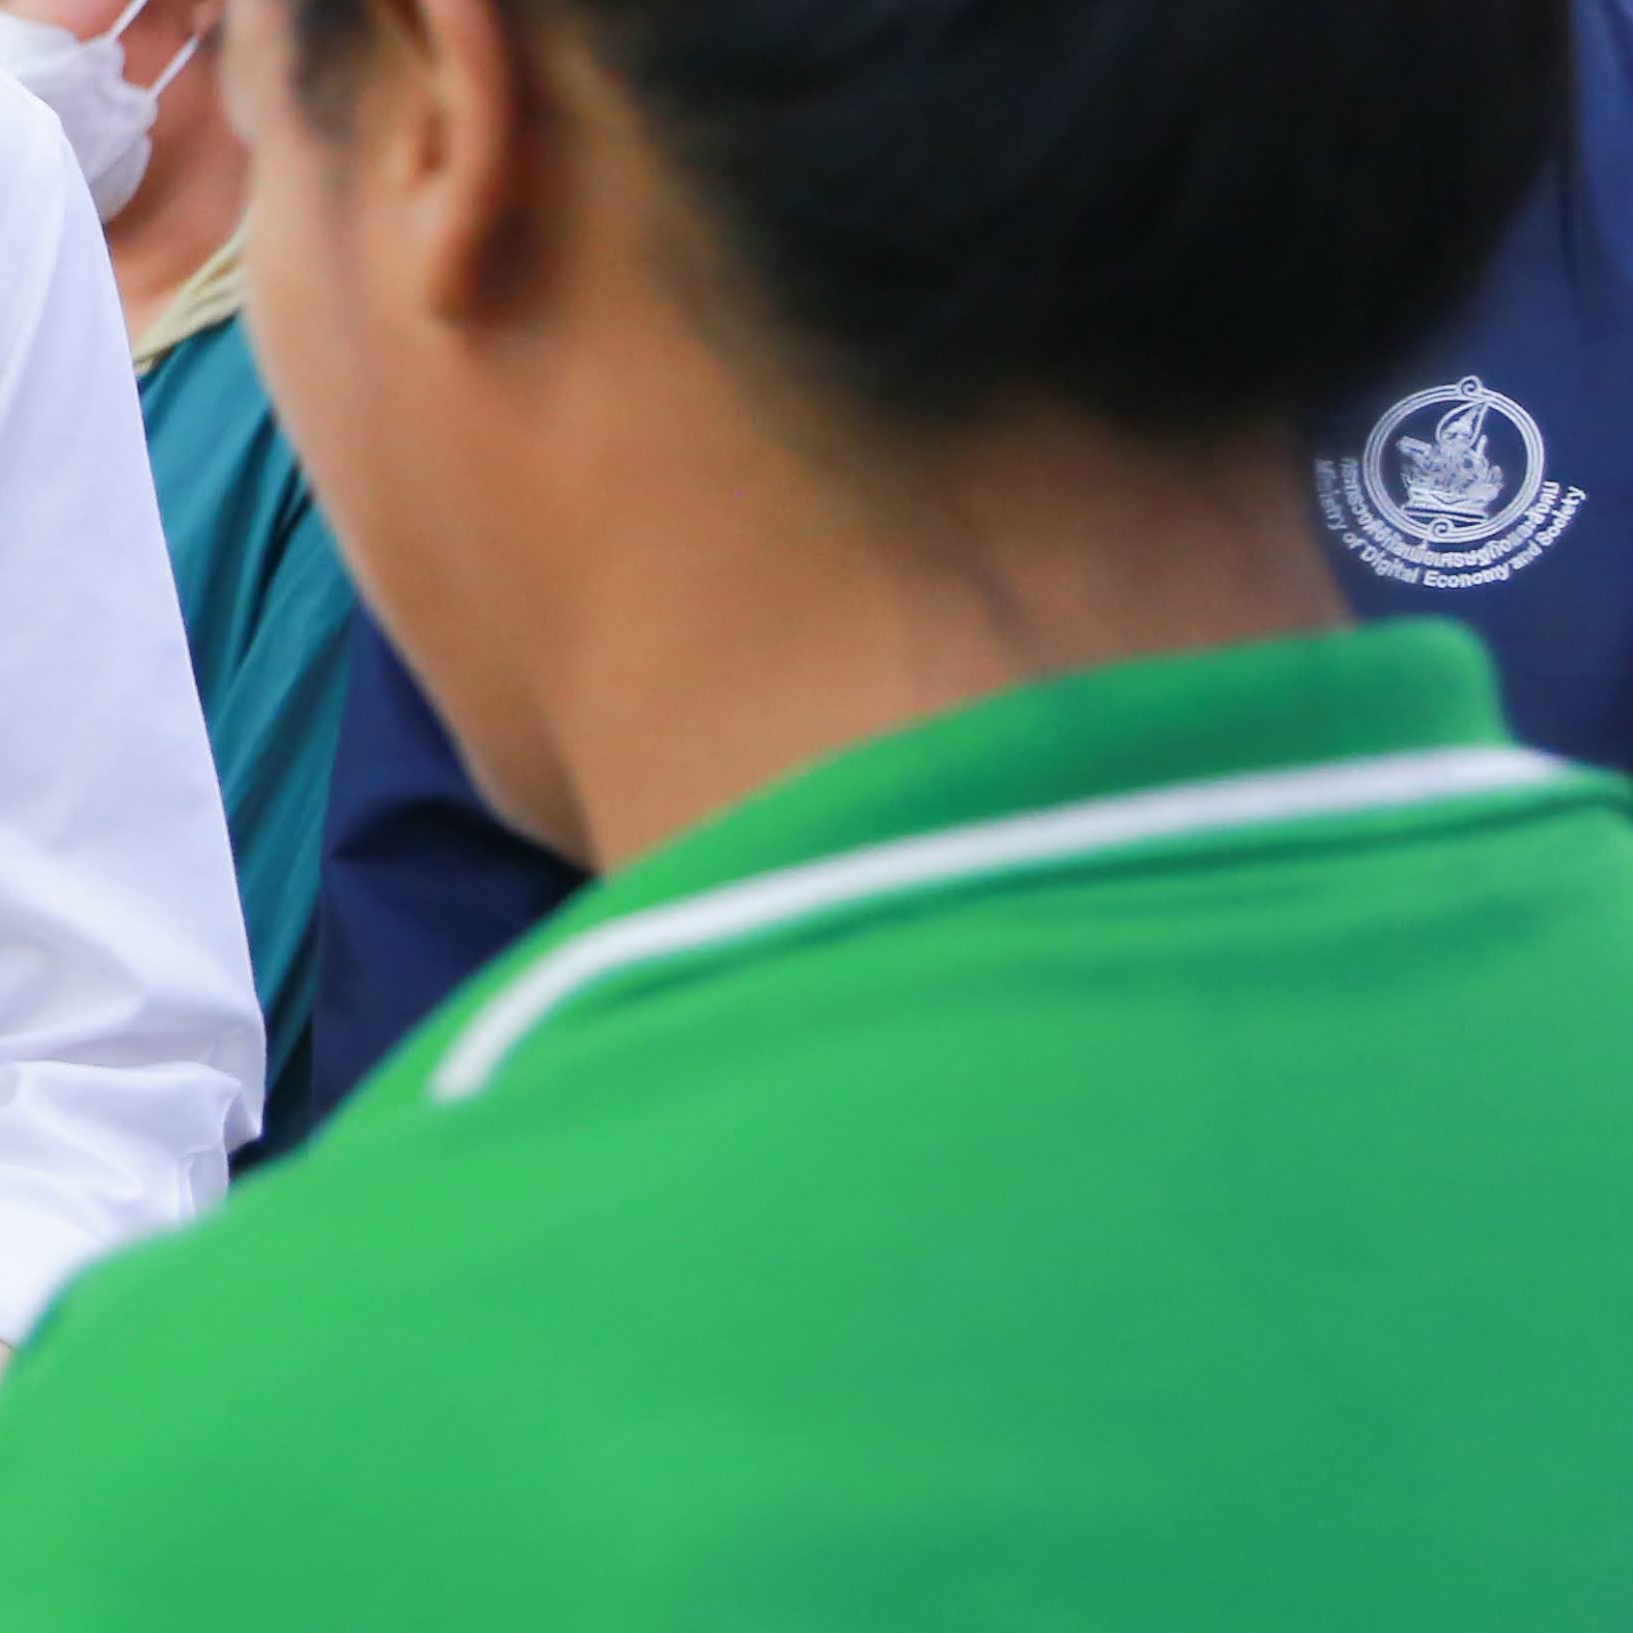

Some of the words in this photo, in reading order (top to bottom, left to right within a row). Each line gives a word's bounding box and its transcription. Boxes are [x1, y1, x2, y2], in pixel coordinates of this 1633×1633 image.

[1342, 532, 1368, 550] of
[1359, 546, 1421, 584] Digital
[1422, 562, 1510, 589] Economy
[1510, 538, 1543, 570] and
[1535, 485, 1587, 547] Society
